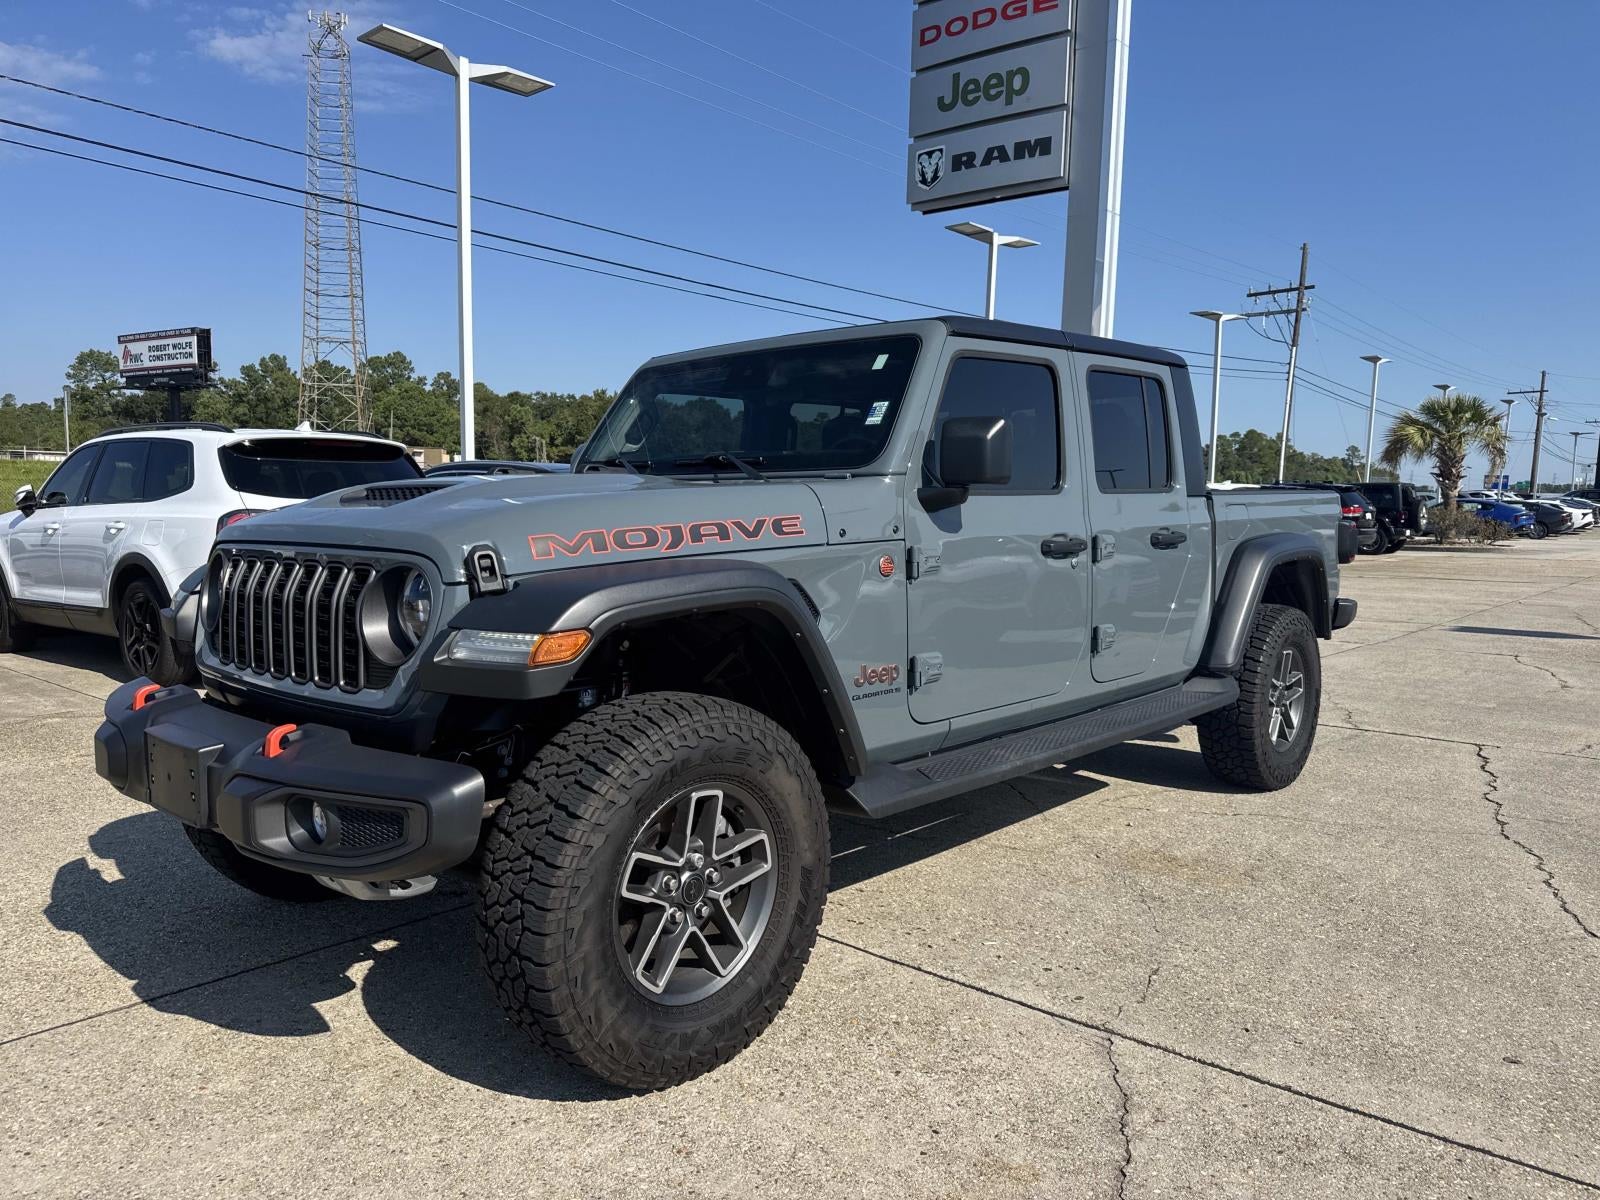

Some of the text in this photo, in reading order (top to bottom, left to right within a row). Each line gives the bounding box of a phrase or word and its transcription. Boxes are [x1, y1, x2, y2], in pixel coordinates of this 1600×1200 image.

[919, 0, 1059, 47] DODGE
[937, 66, 1030, 112] Jeep
[951, 136, 1052, 172] RAM
[129, 352, 143, 364] RWC
[148, 341, 192, 353] ROBERT WOLFE
[148, 352, 193, 362] CONSTRUCTION
[528, 515, 805, 560] MOJAVE
[853, 664, 900, 688] Jeep
[851, 688, 894, 702] GLADIATOR
